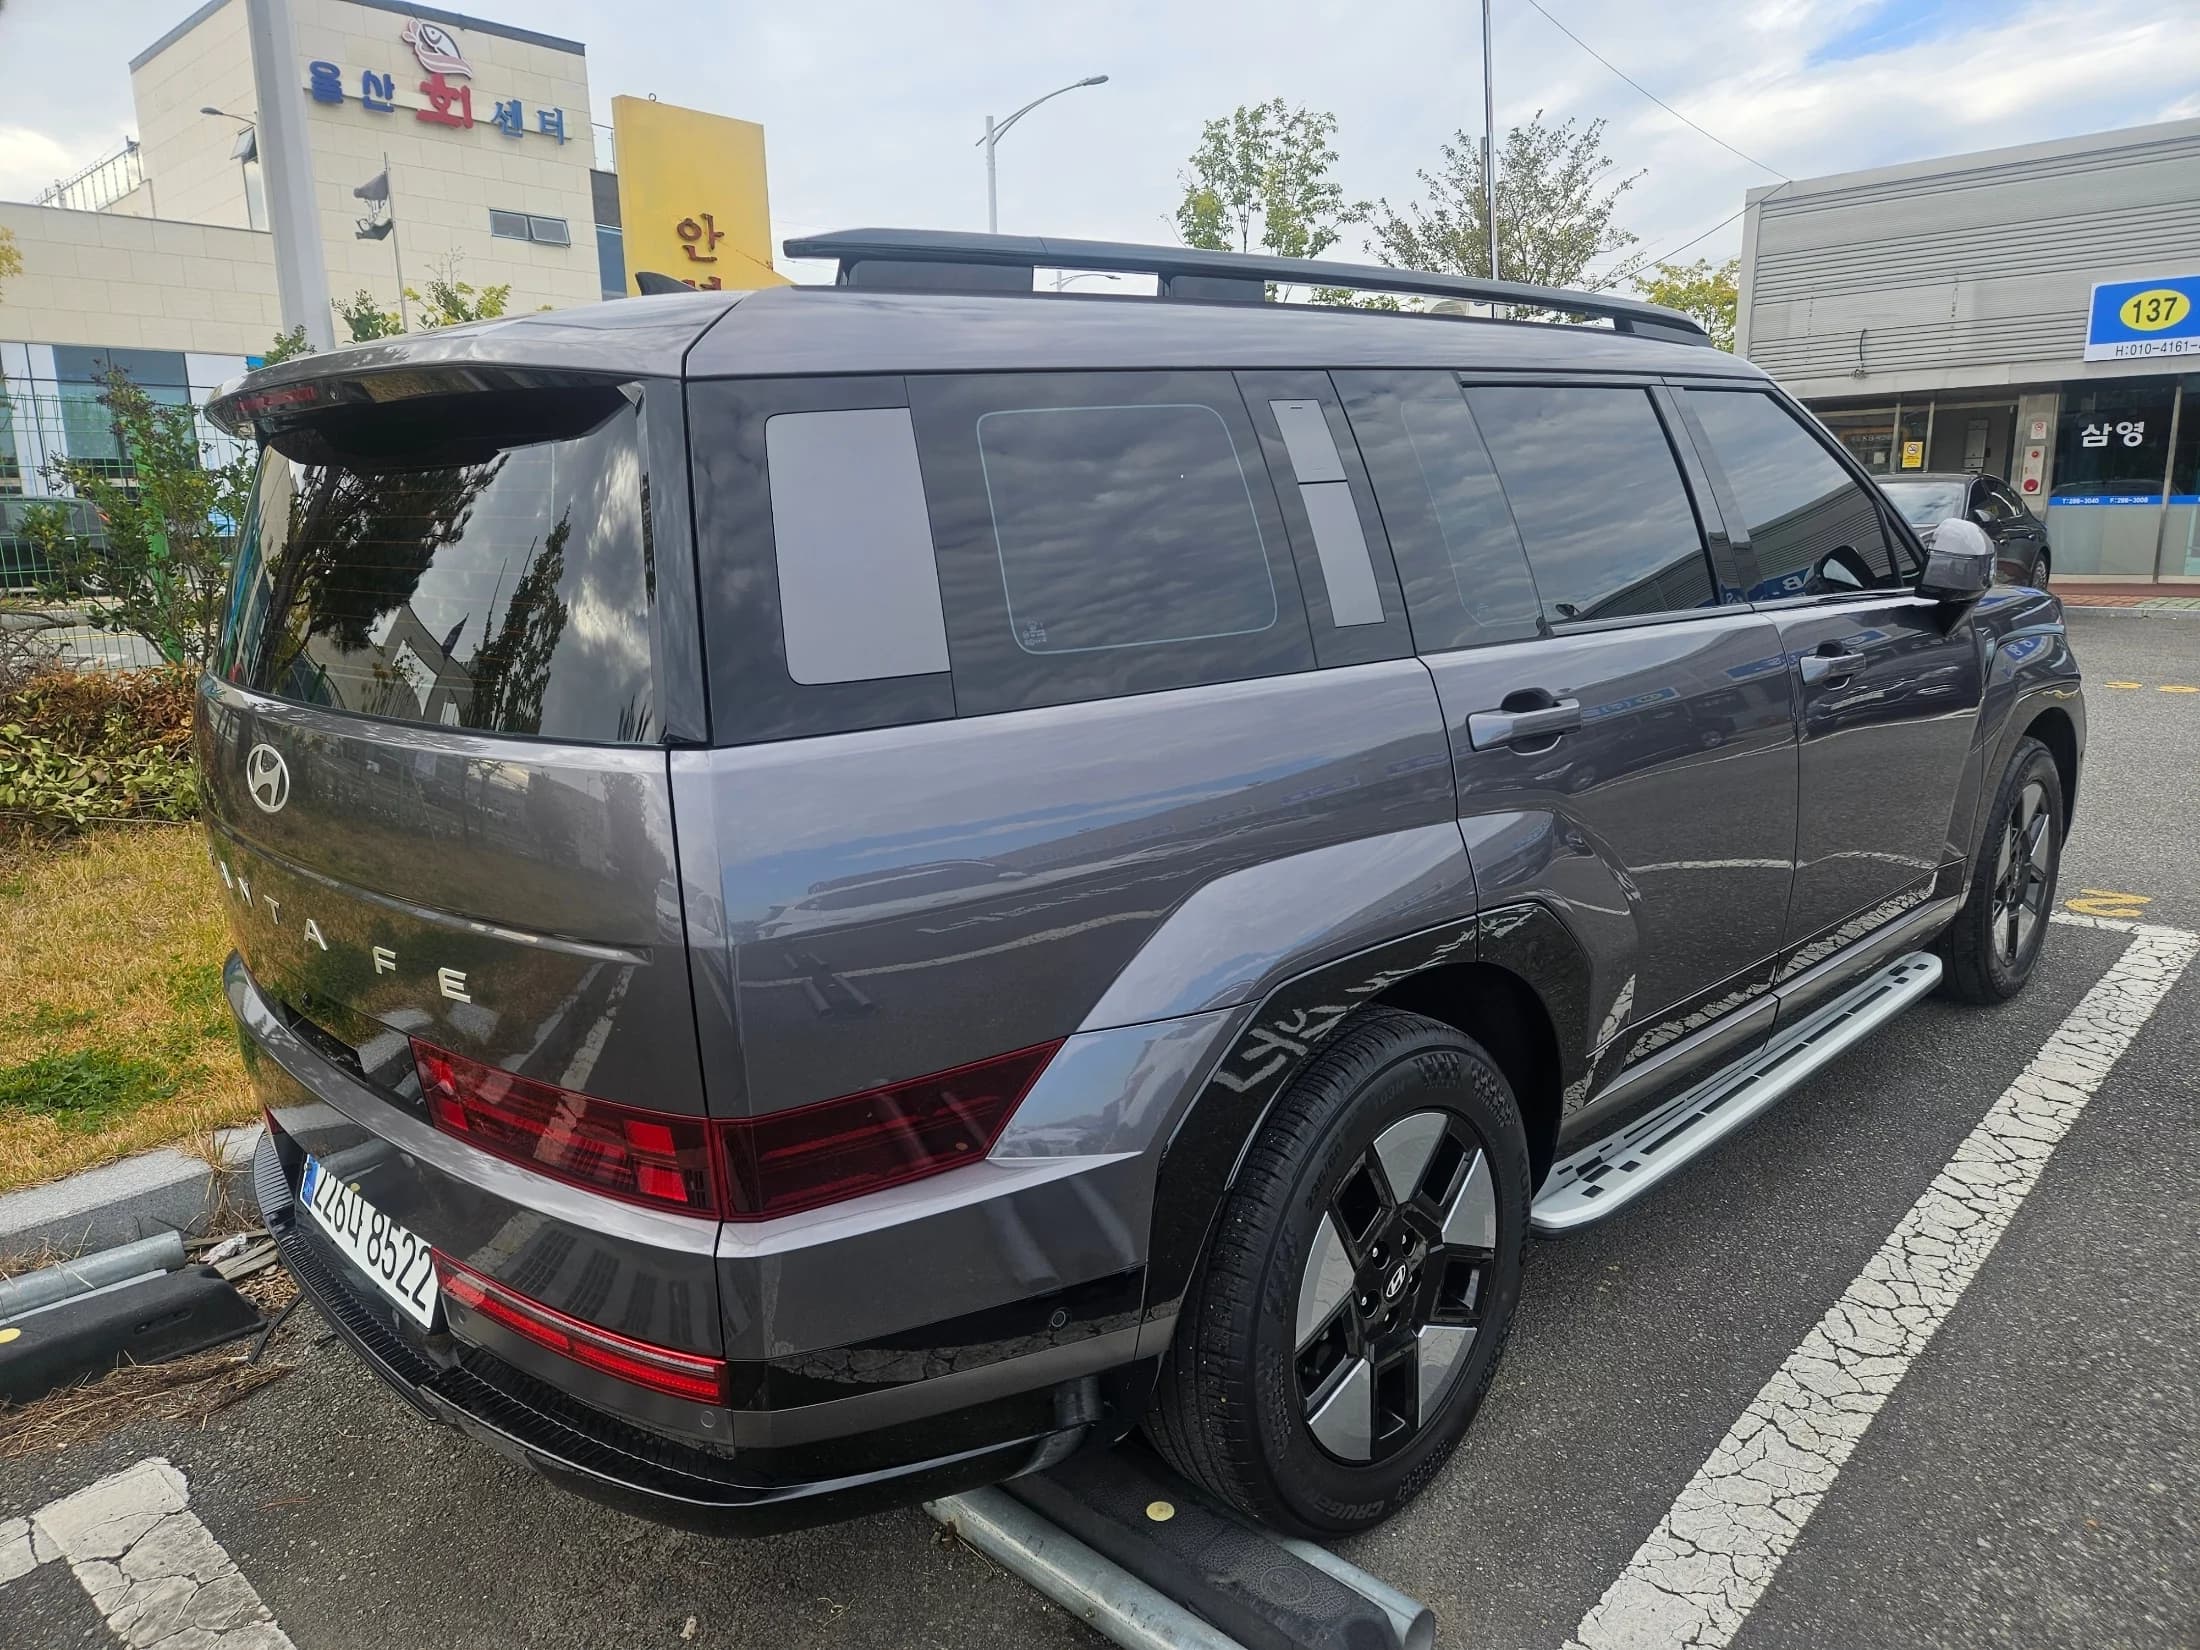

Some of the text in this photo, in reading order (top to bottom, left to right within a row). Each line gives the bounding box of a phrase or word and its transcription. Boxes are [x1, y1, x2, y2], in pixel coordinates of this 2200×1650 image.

[2132, 296, 2178, 324] 137
[2081, 421, 2145, 448] 삼영
[373, 945, 472, 1005] FE
[366, 1213, 433, 1313] 8522
